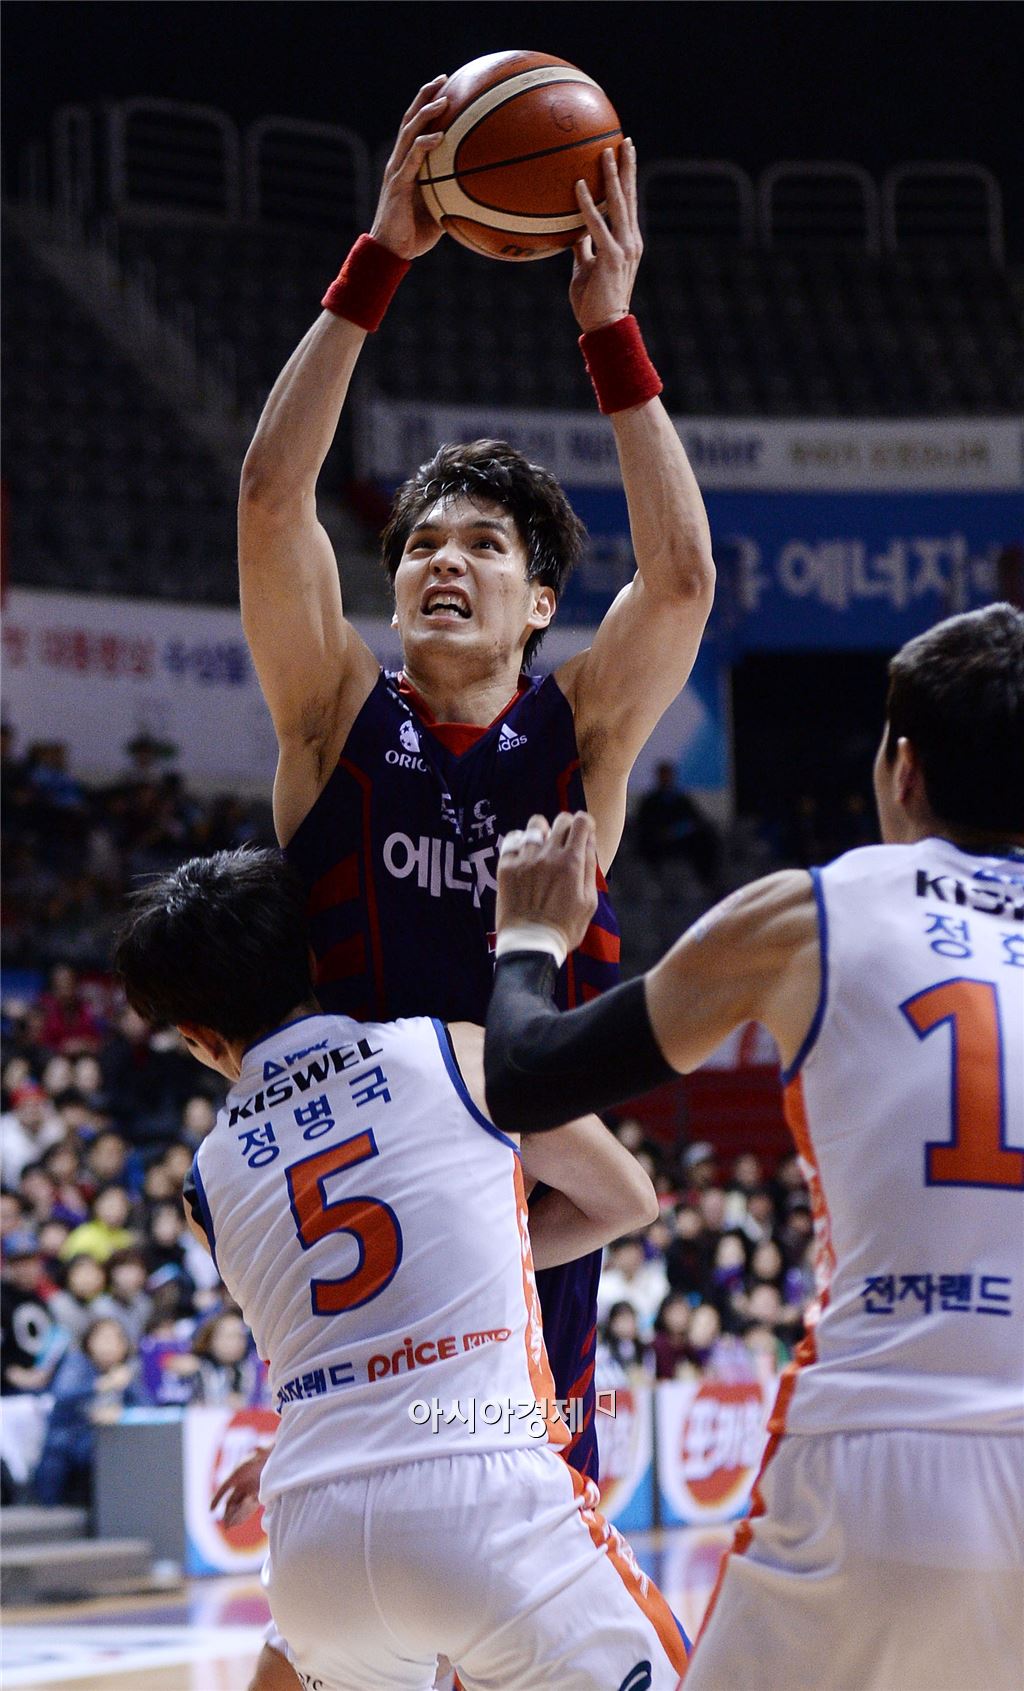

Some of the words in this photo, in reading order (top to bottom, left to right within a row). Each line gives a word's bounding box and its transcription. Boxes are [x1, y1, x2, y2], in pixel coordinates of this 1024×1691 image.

[228, 1038, 383, 1128] KISWEL
[284, 1127, 403, 1316] 5
[864, 1273, 1012, 1317] 전자랜드
